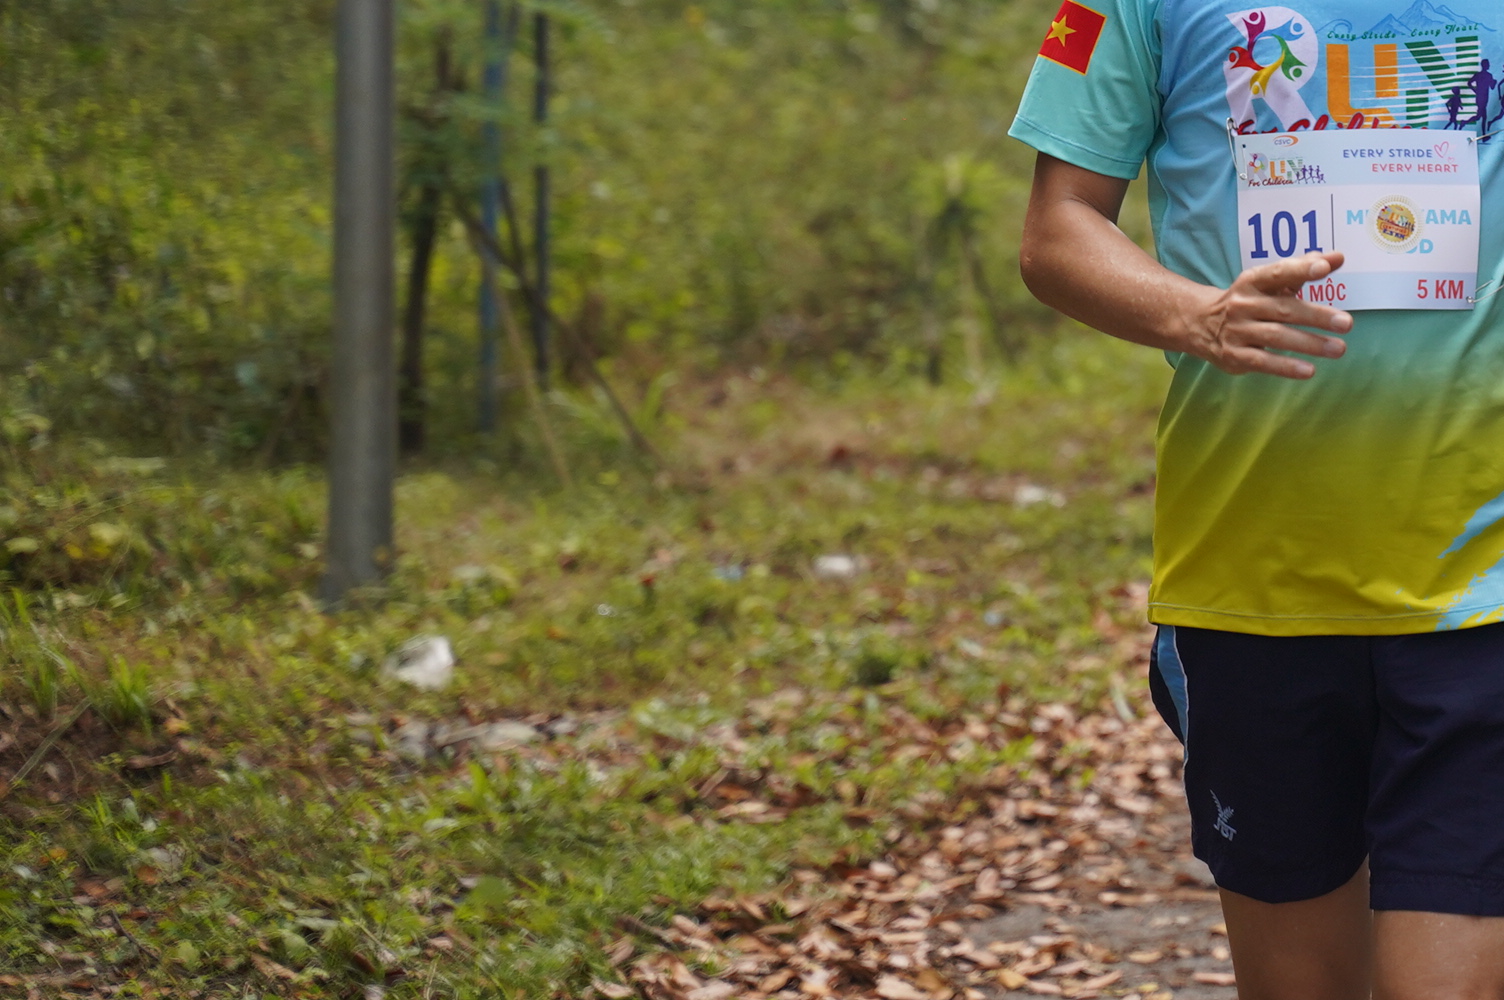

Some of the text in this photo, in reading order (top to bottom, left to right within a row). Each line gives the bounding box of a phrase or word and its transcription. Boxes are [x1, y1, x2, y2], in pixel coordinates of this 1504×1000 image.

[1223, 6, 1480, 131] RUN
[1343, 149, 1433, 158] EVERY STRIDE
[1372, 163, 1458, 173] EVERY HEART
[1262, 178, 1294, 187] Children
[1248, 210, 1323, 259] 101
[1309, 278, 1346, 306] MỘC
[1417, 279, 1464, 300] 5 KM
